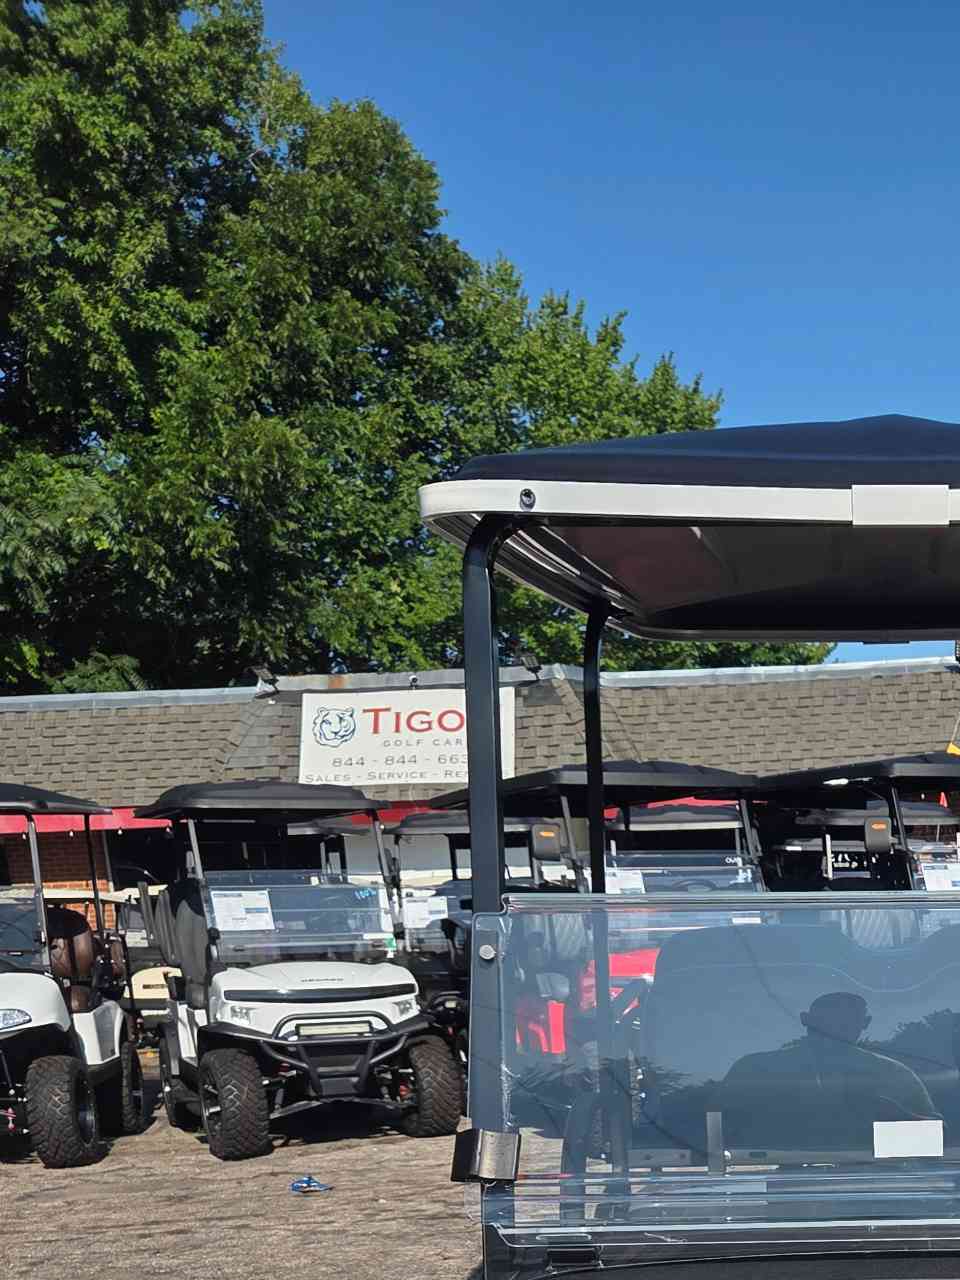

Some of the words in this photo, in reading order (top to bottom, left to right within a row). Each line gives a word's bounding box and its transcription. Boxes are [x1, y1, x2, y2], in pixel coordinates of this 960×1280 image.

[383, 738, 425, 748] GOLF
[332, 756, 366, 767] 844
[384, 754, 418, 766] 844
[304, 773, 351, 783] SALES
[367, 770, 429, 781] SERVICE
